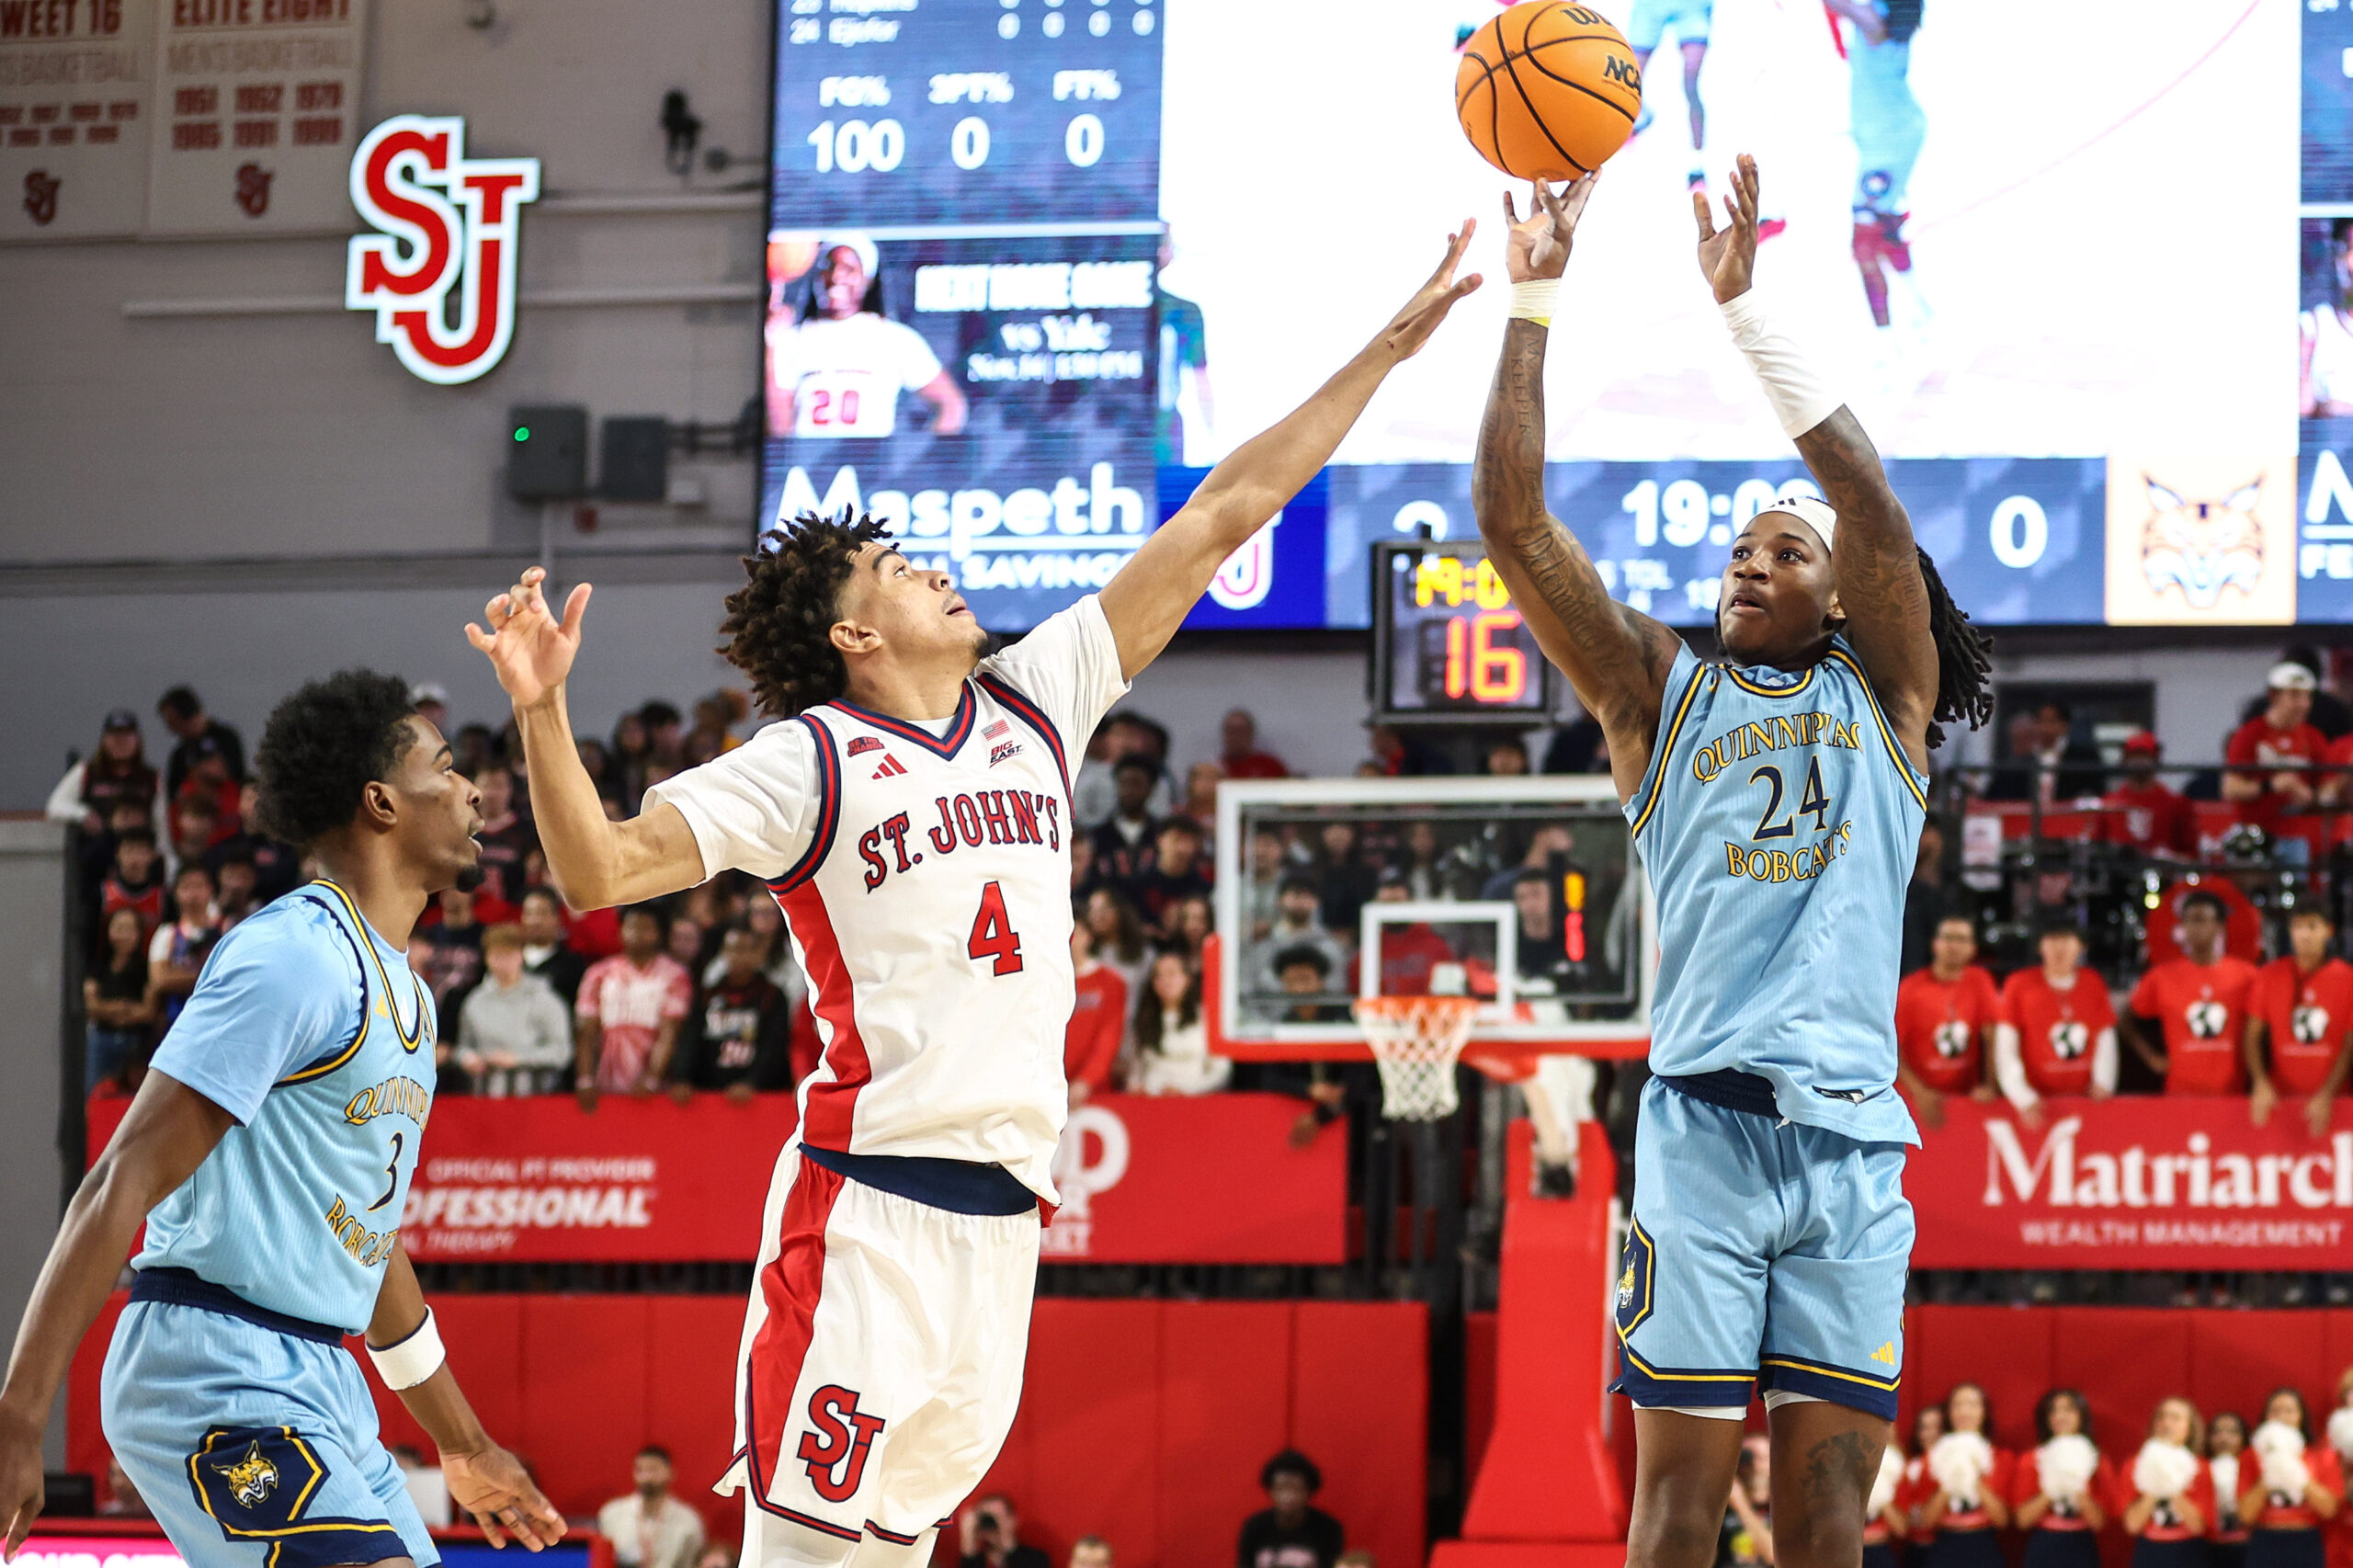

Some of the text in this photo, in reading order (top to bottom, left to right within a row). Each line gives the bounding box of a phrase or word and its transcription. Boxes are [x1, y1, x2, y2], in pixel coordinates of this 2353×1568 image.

[0, 0, 121, 38] WEET 16
[173, 0, 251, 27] ELITE
[808, 114, 1105, 173] 100 0 0
[813, 390, 859, 425] 20
[775, 462, 1145, 562] Maspeth
[1621, 479, 1823, 548] 19:0
[1989, 494, 2049, 569] 0
[961, 552, 1138, 589] SAVING
[1446, 609, 1527, 702] 16
[990, 744, 1023, 764] EAST
[991, 740, 1014, 756] BIG
[1749, 754, 1831, 842] 24
[858, 790, 1059, 894] ST. JOHN'S
[1724, 820, 1852, 883] BOBCATS
[968, 881, 1023, 977] 4
[366, 1131, 404, 1212] 3
[401, 1185, 652, 1229] OFESSIONAL
[2021, 1220, 2343, 1247] WEALTH MANAGEMENT
